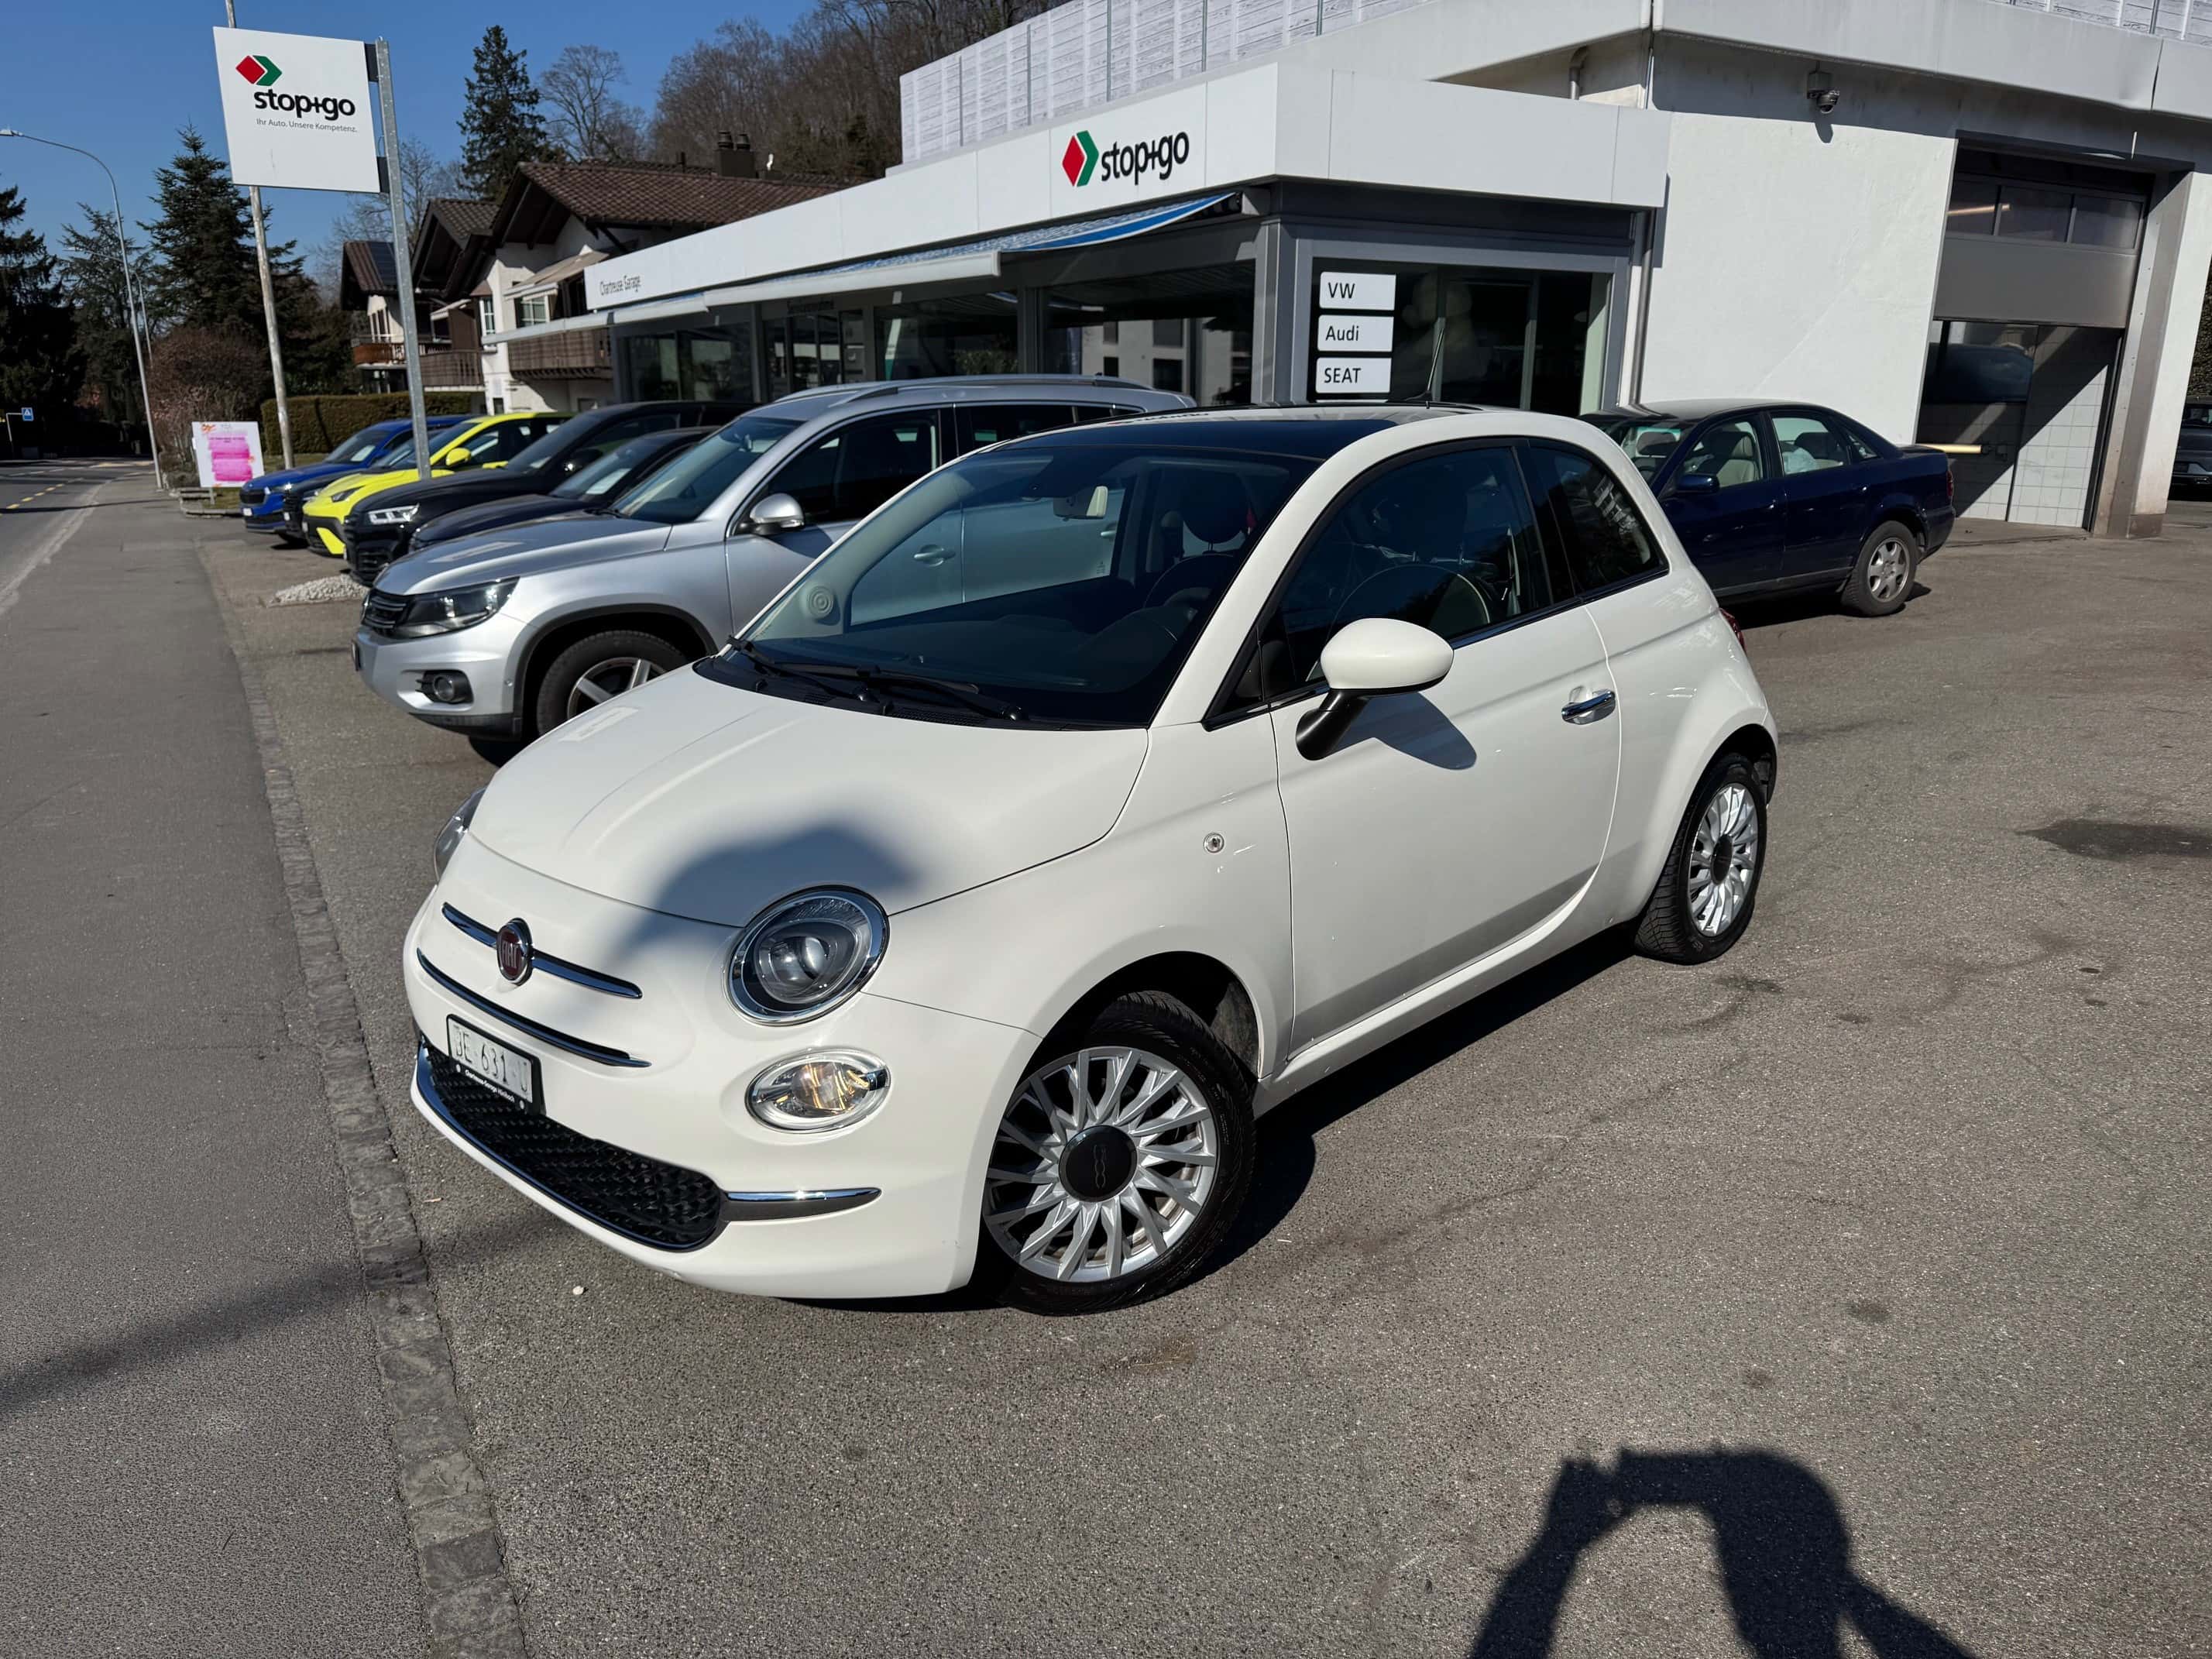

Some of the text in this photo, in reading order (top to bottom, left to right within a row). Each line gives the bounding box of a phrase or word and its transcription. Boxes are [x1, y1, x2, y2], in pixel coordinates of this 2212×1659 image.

[253, 88, 356, 121] stop+go
[268, 118, 288, 128] Auto.
[289, 121, 314, 129] Unsere
[315, 123, 358, 133] Kompetenz.
[1101, 131, 1190, 186] stop+go
[1328, 282, 1355, 299] VW
[1325, 325, 1359, 342] Audi
[1324, 367, 1362, 383] SEAT
